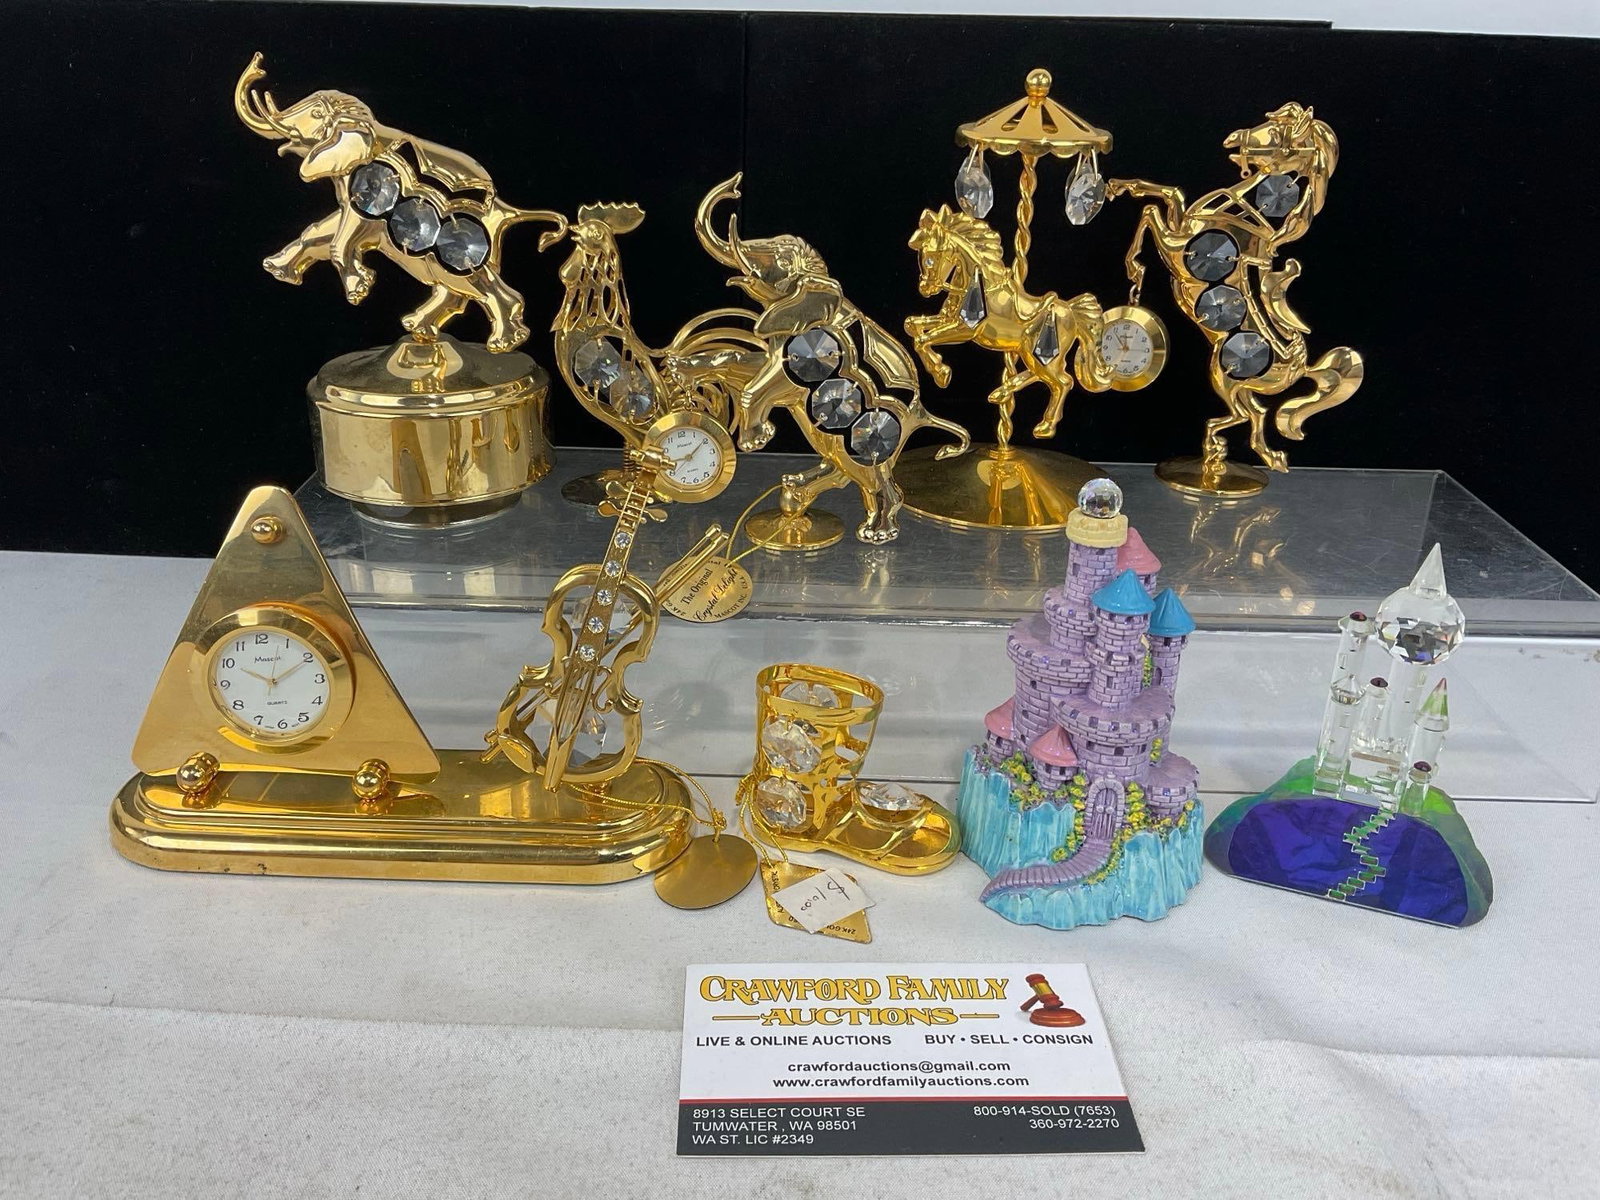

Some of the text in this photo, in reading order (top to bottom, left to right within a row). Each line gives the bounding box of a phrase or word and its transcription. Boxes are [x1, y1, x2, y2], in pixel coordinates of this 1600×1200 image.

[681, 568, 713, 605] The Original
[693, 592, 719, 621] Crystal
[714, 568, 738, 595] Delight
[713, 602, 739, 619] MASCOT
[255, 633, 269, 644] 12
[286, 638, 290, 649] 1
[236, 641, 245, 652] 11
[303, 652, 314, 663] 2
[222, 658, 235, 669] 10
[314, 673, 325, 684] 3
[220, 680, 231, 690] 9
[232, 700, 244, 710] 8
[311, 695, 323, 706] 4
[253, 715, 264, 725] 7
[298, 712, 309, 723] 5
[277, 718, 288, 729] 6
[700, 975, 1009, 1005] CRAWFORD FAMILY
[761, 1008, 959, 1026] AUCTIONS
[696, 1035, 892, 1046] LIVE & ONLINE AUCTIONS
[925, 1034, 1094, 1044] BUY SELL CONSIGN
[788, 1061, 1011, 1073] crawfordauctions@gmail.com
[773, 1076, 1030, 1088] www.crawfordfamilyauctions.com
[693, 1107, 866, 1118] 8913 SELECT COURT SE
[973, 1105, 1116, 1117] 800-914-SOLD (7653)
[693, 1121, 778, 1132] TUMWATER
[789, 1121, 814, 1131] WA
[817, 1120, 857, 1131] 98501
[1029, 1118, 1120, 1129] 360-972-2270
[692, 1134, 814, 1145] WA ST. LIC #2349
